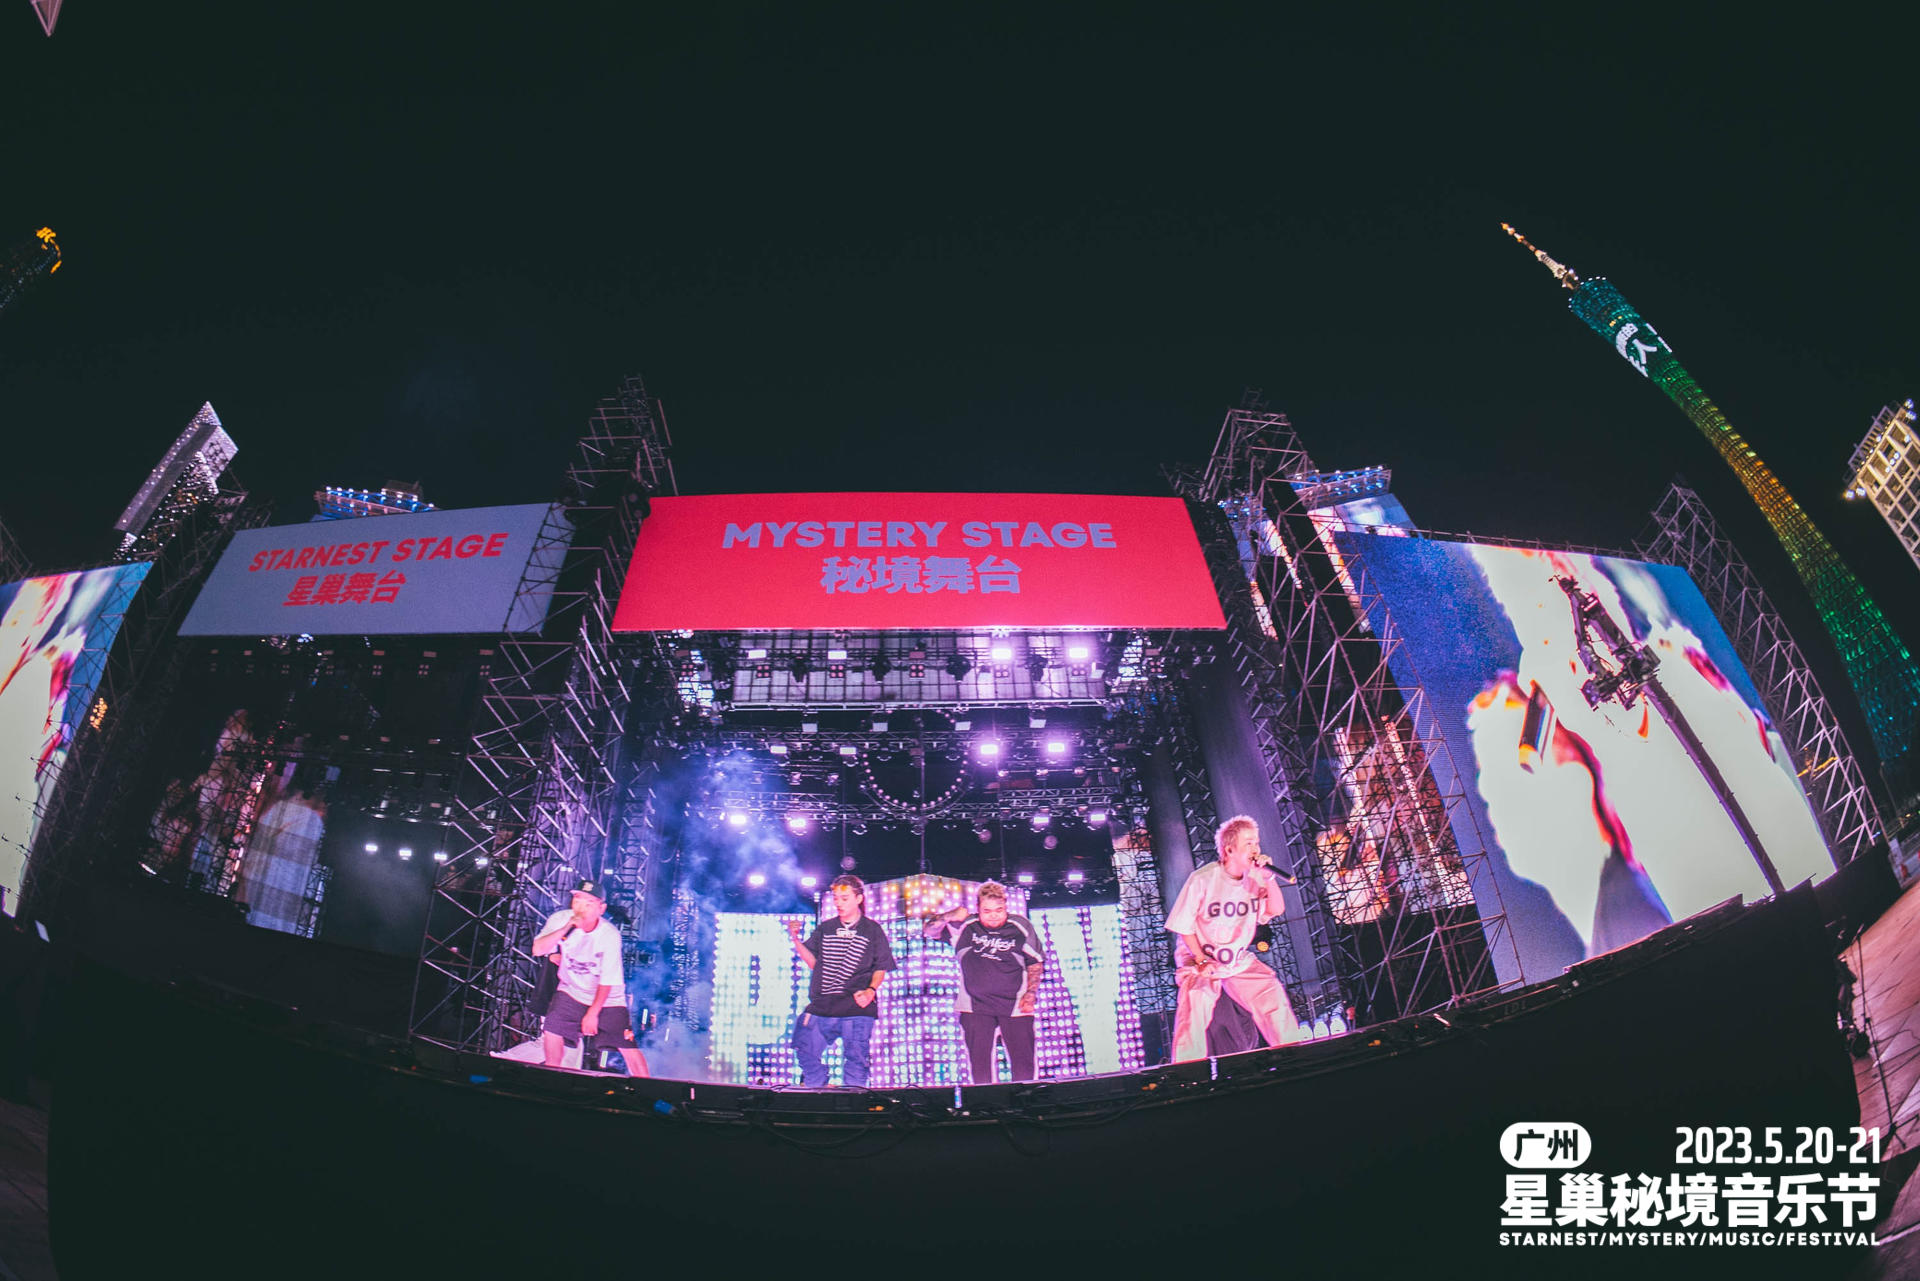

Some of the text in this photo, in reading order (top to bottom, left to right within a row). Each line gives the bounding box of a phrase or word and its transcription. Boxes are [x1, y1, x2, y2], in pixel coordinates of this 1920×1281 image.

[249, 533, 509, 572] STARNEST STAGE
[722, 521, 1117, 549] MYSTERY STAGE
[282, 569, 407, 607] 星巢舞台
[820, 554, 1022, 595] 秘境舞台
